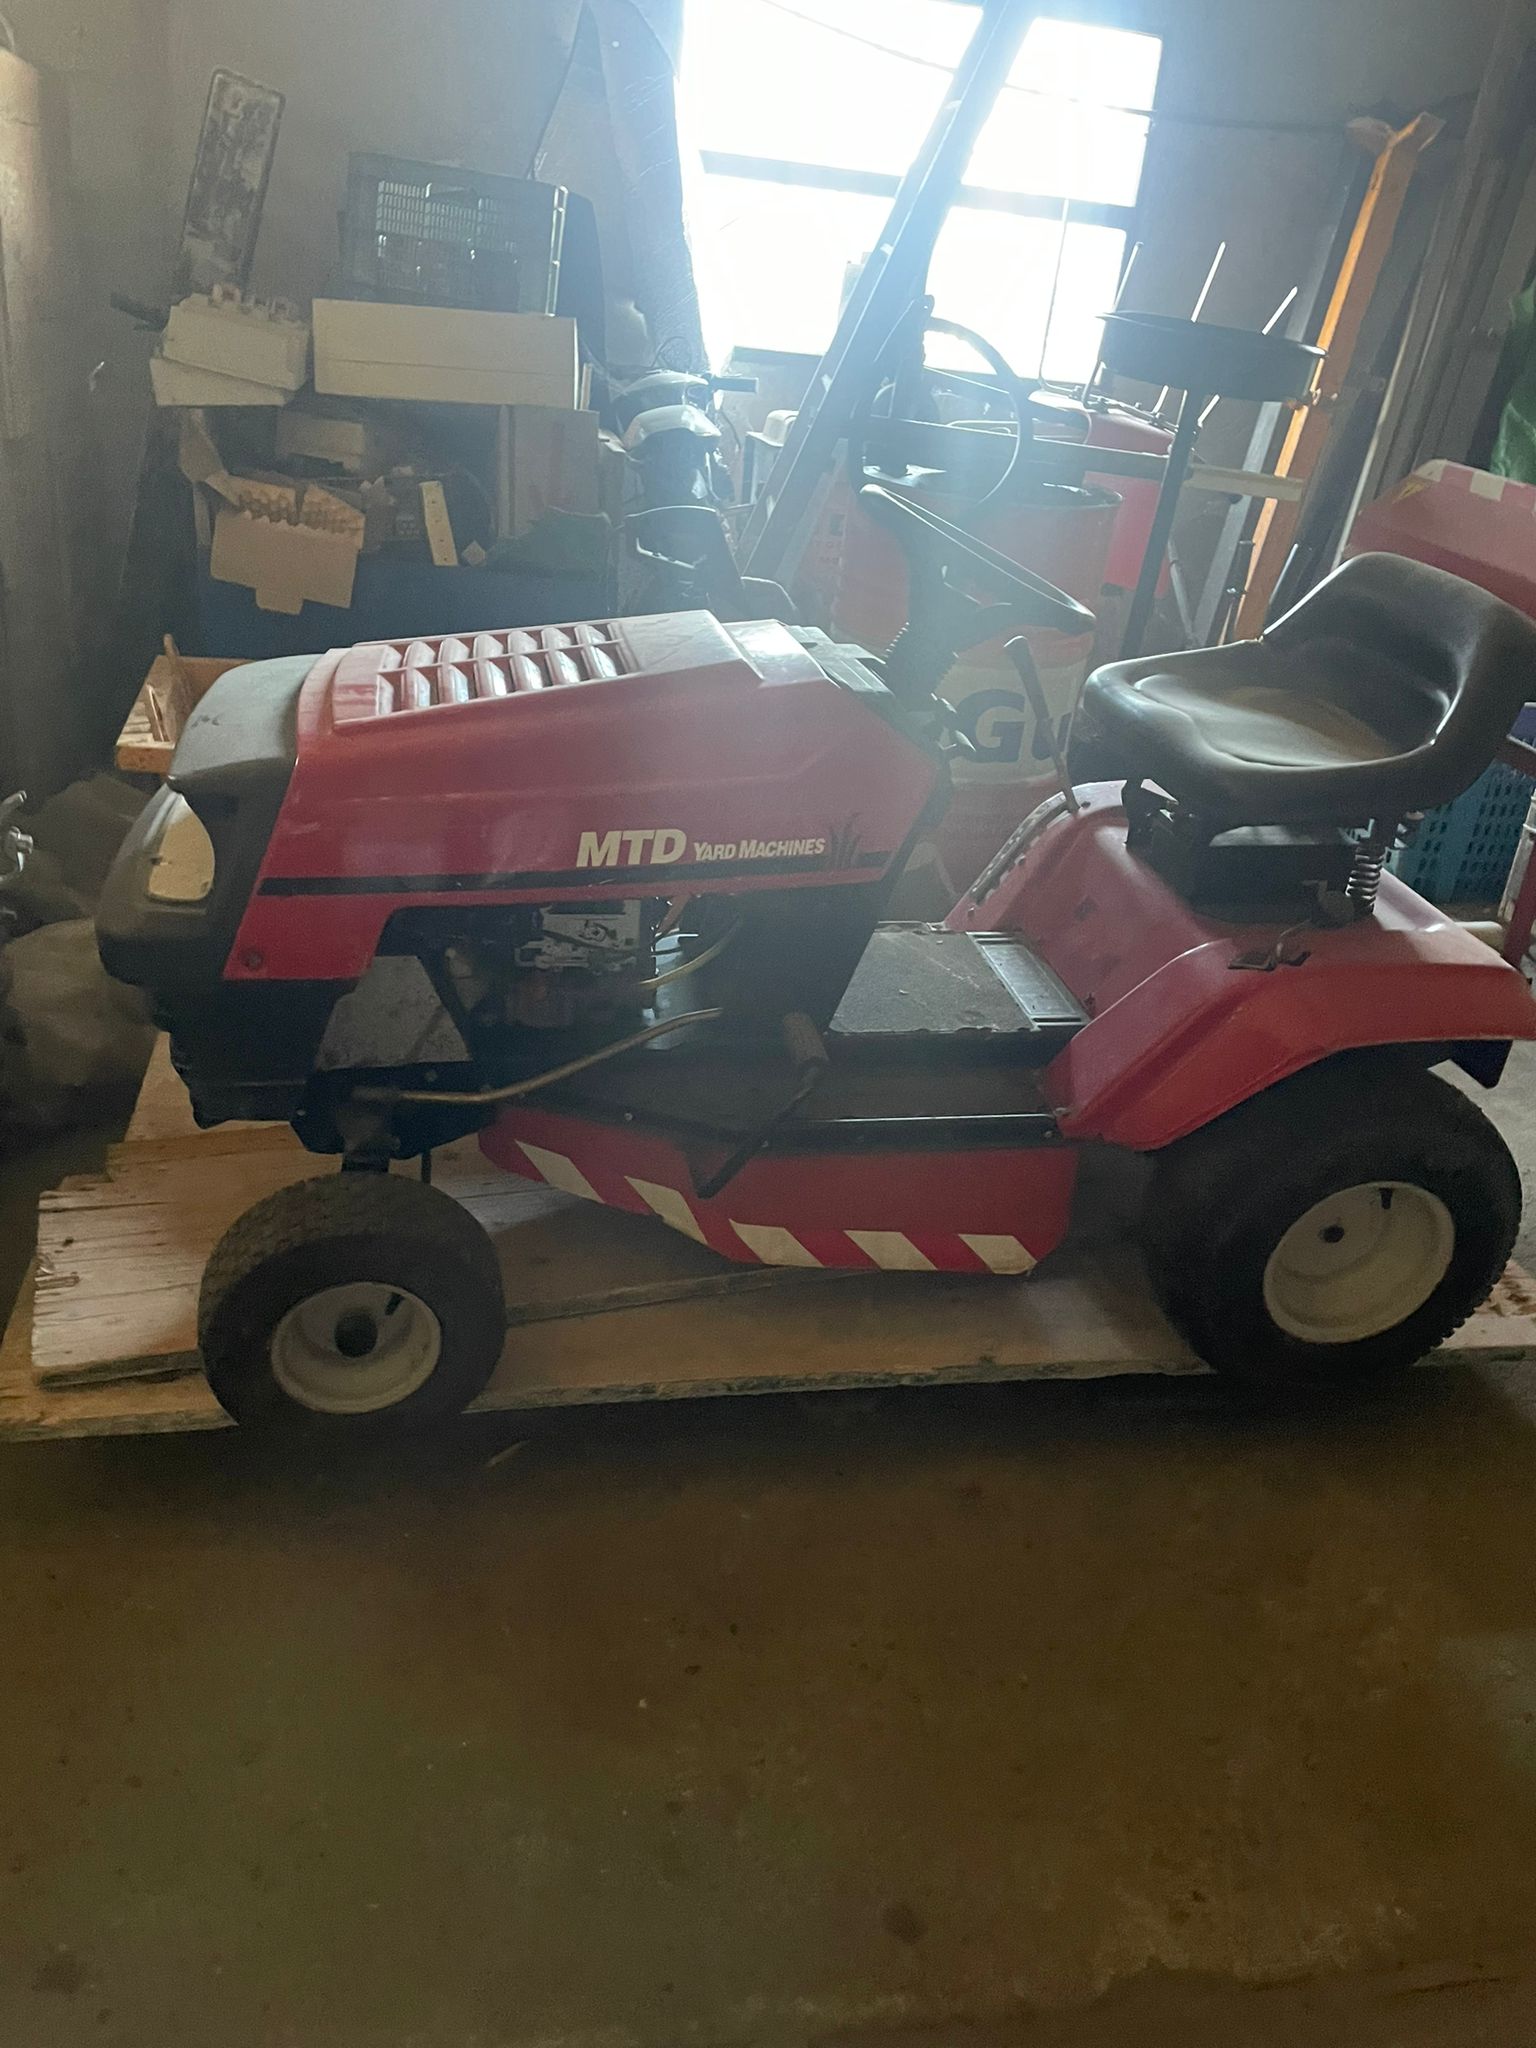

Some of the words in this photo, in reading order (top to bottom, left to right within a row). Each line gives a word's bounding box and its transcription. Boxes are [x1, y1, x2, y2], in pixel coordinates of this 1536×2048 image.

[576, 828, 687, 868] MTD
[694, 841, 737, 861] YARD
[739, 838, 826, 858] MACHINES
